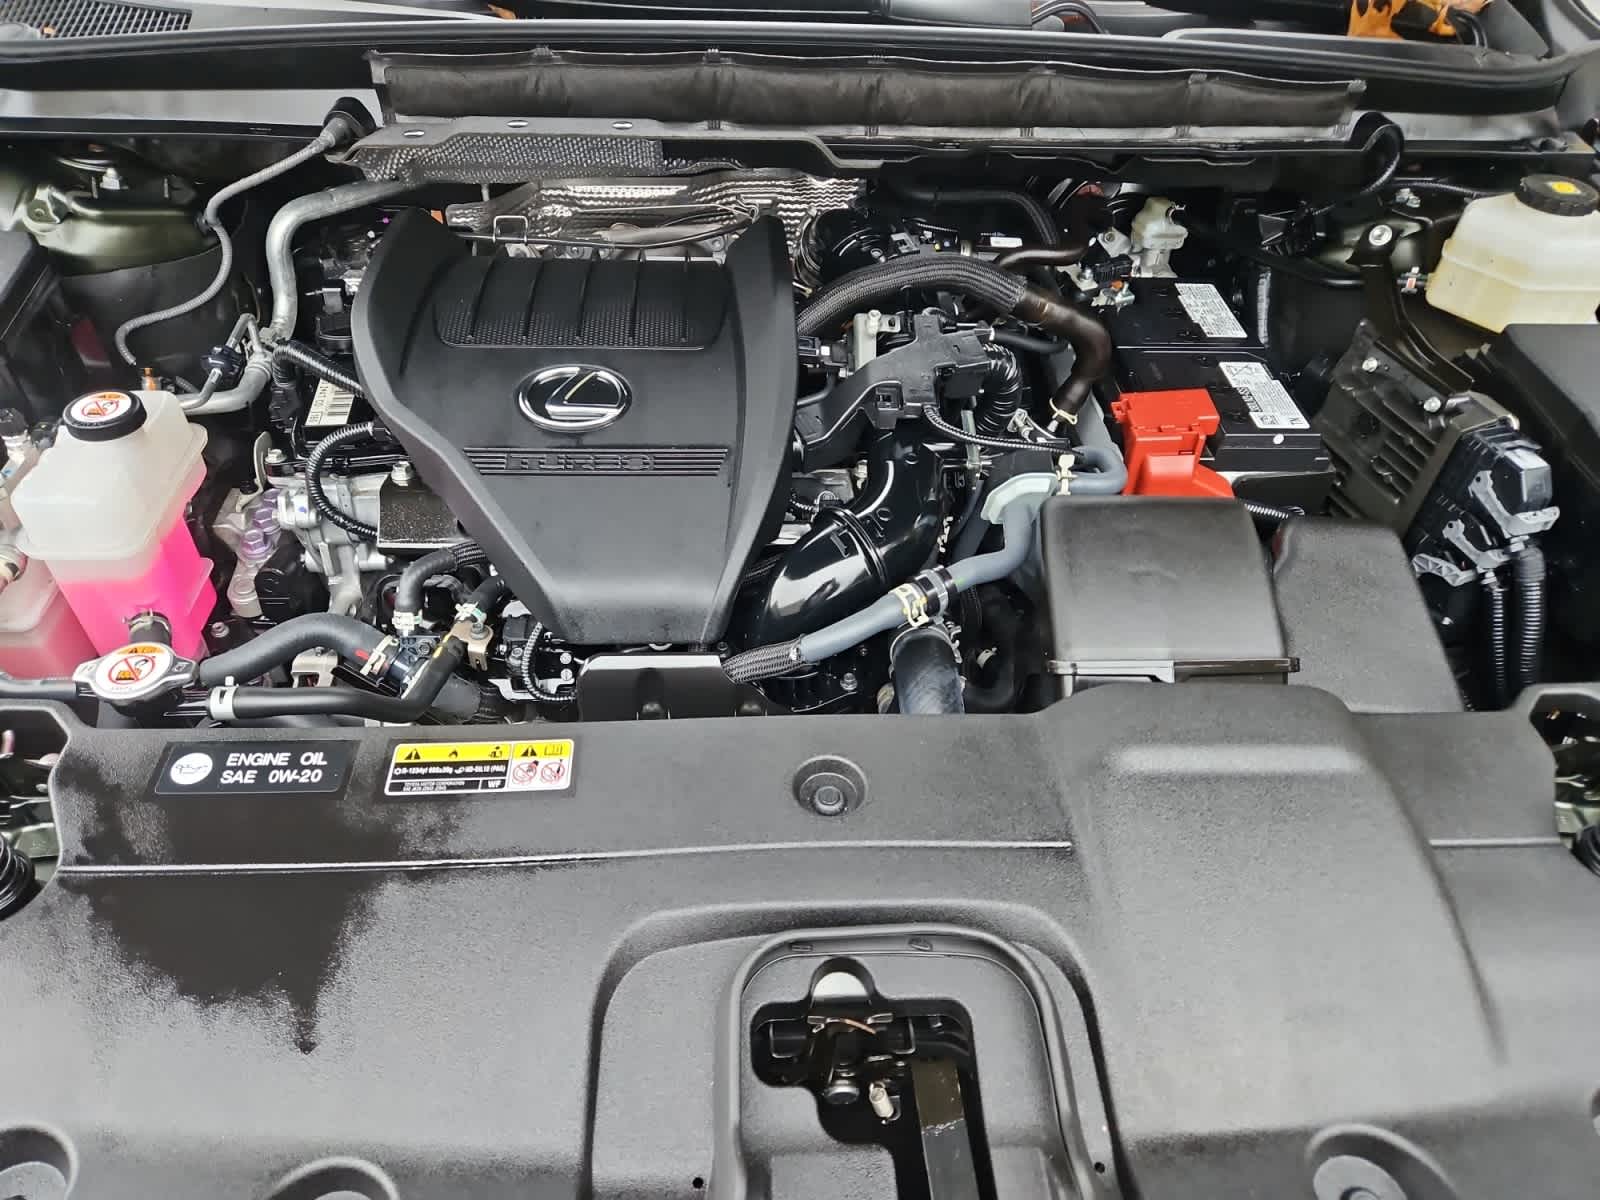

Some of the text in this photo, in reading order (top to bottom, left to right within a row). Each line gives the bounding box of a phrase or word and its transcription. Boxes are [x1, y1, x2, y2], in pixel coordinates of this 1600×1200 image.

[226, 751, 328, 767] ENGINE OIL
[220, 769, 323, 784] SAE 0W-20
